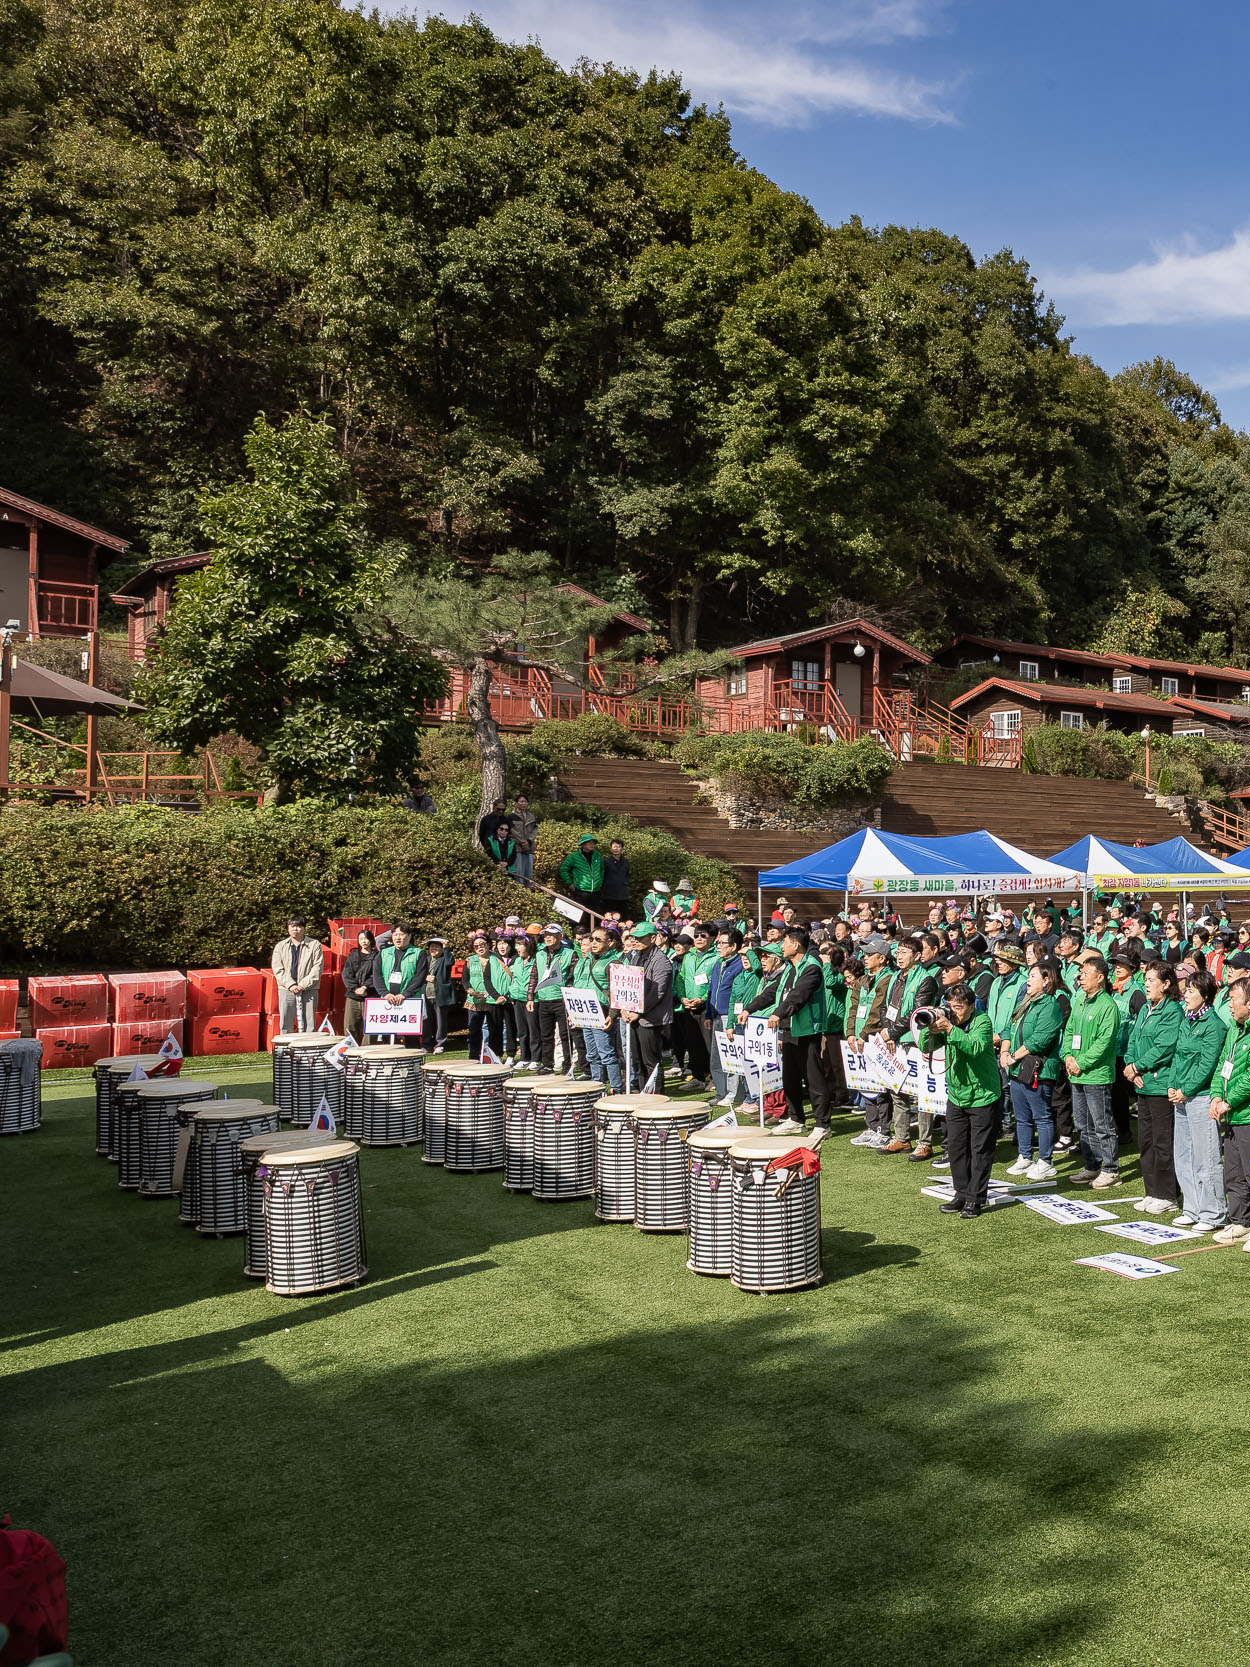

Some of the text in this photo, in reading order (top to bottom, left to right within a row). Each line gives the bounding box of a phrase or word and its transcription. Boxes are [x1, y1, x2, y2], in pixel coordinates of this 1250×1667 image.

[887, 879, 919, 892] 광장동
[923, 879, 958, 892] 새마을,
[960, 879, 996, 891] 하나로!
[999, 878, 1031, 891] 즐겁게!
[1118, 877, 1140, 888] 자양1동
[566, 998, 599, 1014] 자양1동
[369, 1014, 417, 1024] 자양제4동
[748, 1040, 774, 1057] 구의1동
